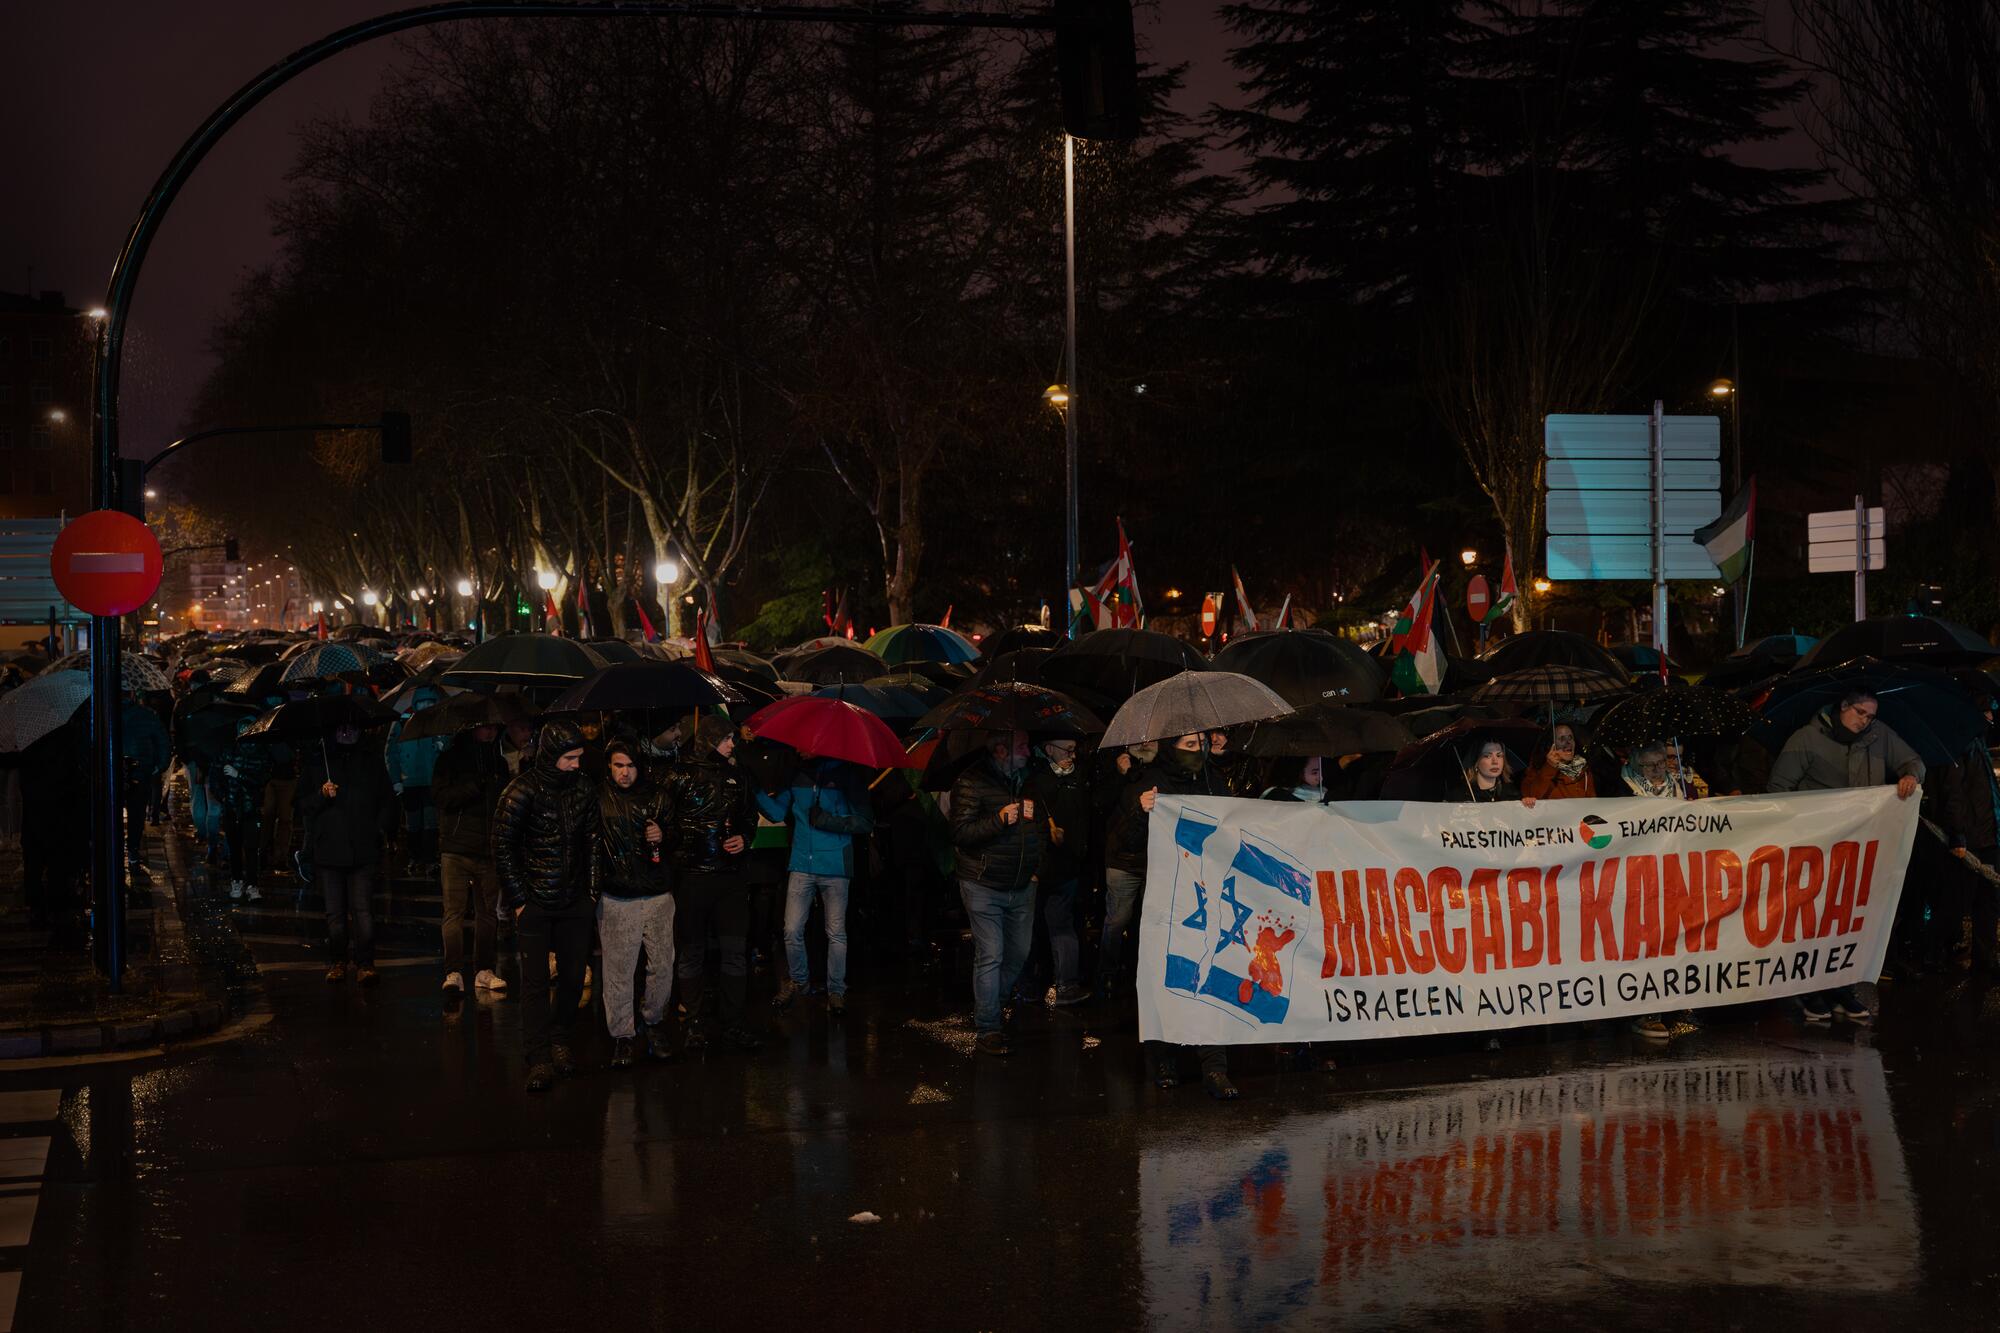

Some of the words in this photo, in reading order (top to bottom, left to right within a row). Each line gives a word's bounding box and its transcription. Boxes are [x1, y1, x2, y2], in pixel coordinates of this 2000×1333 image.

[1441, 827, 1574, 849] PALESTINAREKIN
[1618, 814, 1732, 838] ELKARTASUNA
[1316, 864, 1563, 979] MACCABI
[1579, 839, 1879, 962] KANPORA!
[1324, 985, 1464, 1022] ISRAELEN
[1477, 974, 1606, 1016] AURPEGI
[1617, 948, 1819, 1001] GARBIKETARI
[1825, 943, 1857, 973] EZ
